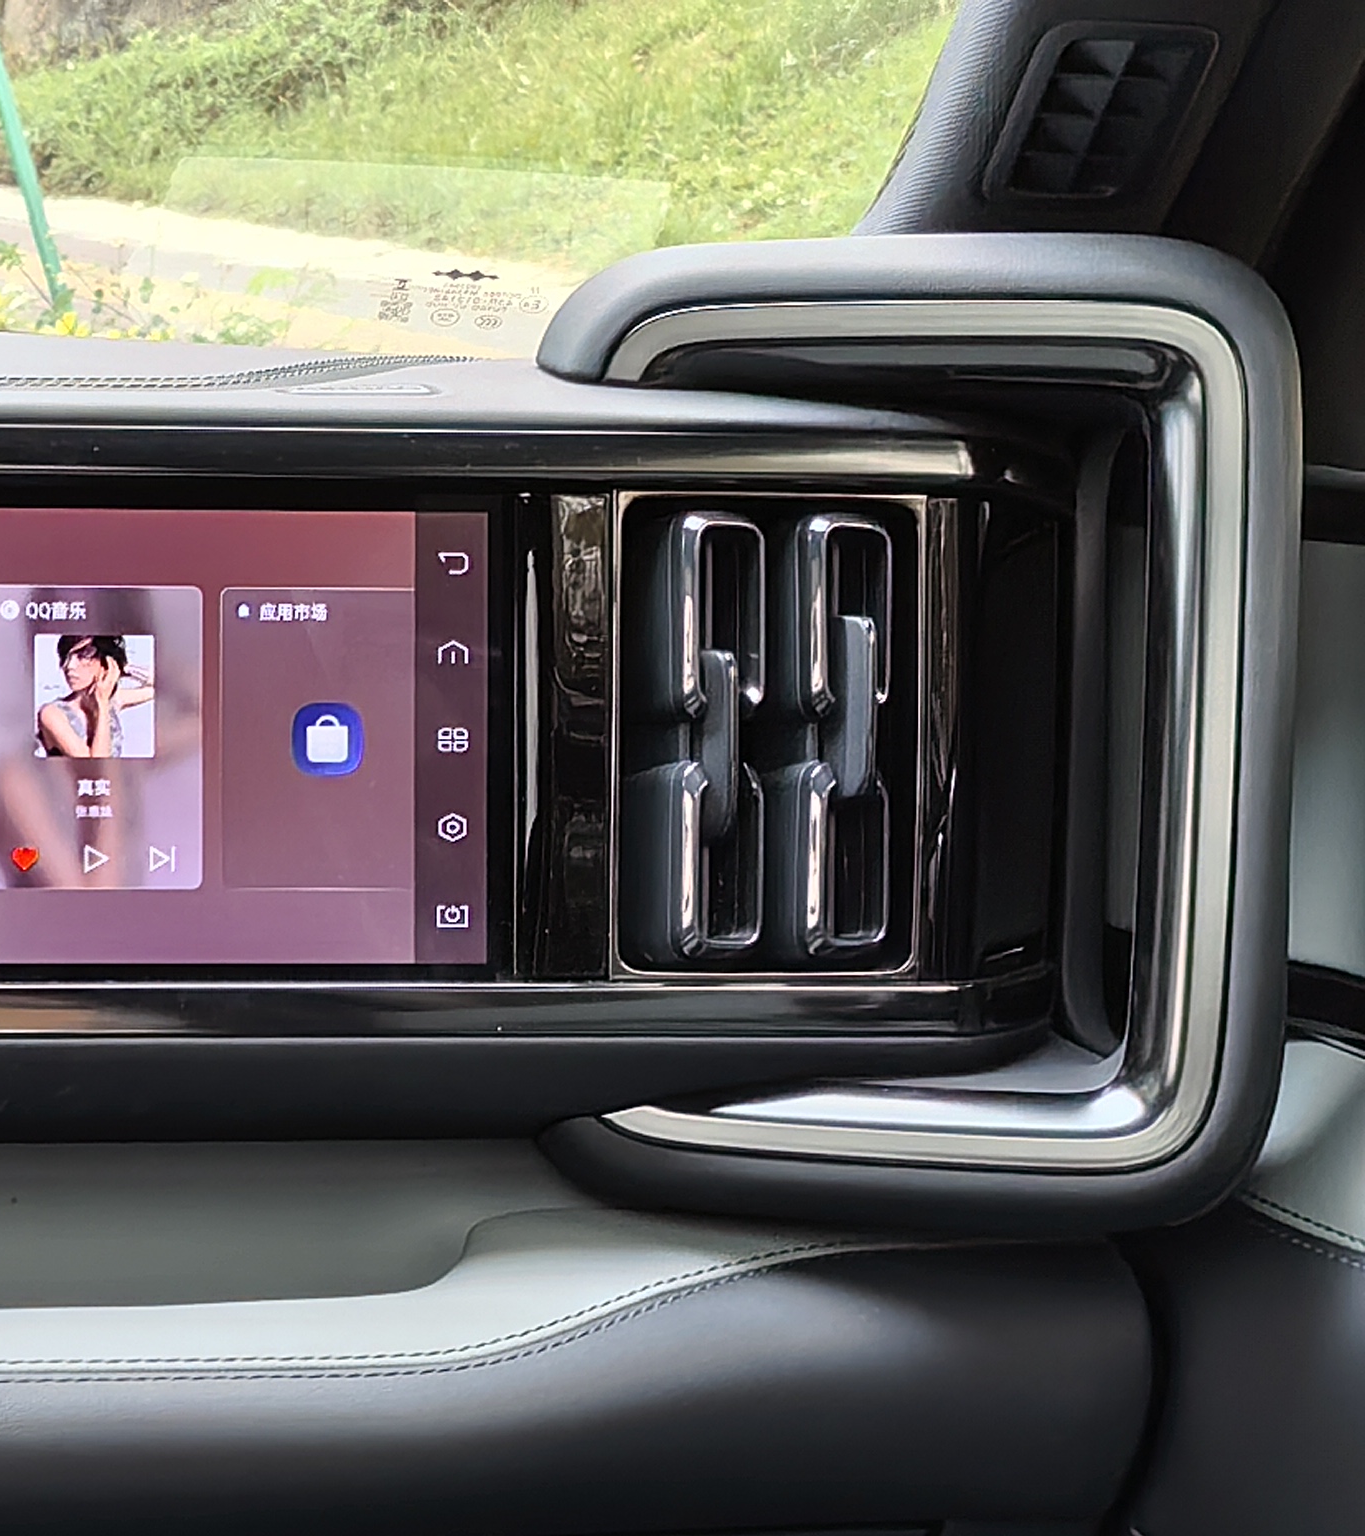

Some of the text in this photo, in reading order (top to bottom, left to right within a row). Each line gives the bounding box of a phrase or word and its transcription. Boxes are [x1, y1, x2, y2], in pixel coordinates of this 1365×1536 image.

[25, 602, 87, 621] QQ音乐
[259, 602, 328, 622] 应用市场
